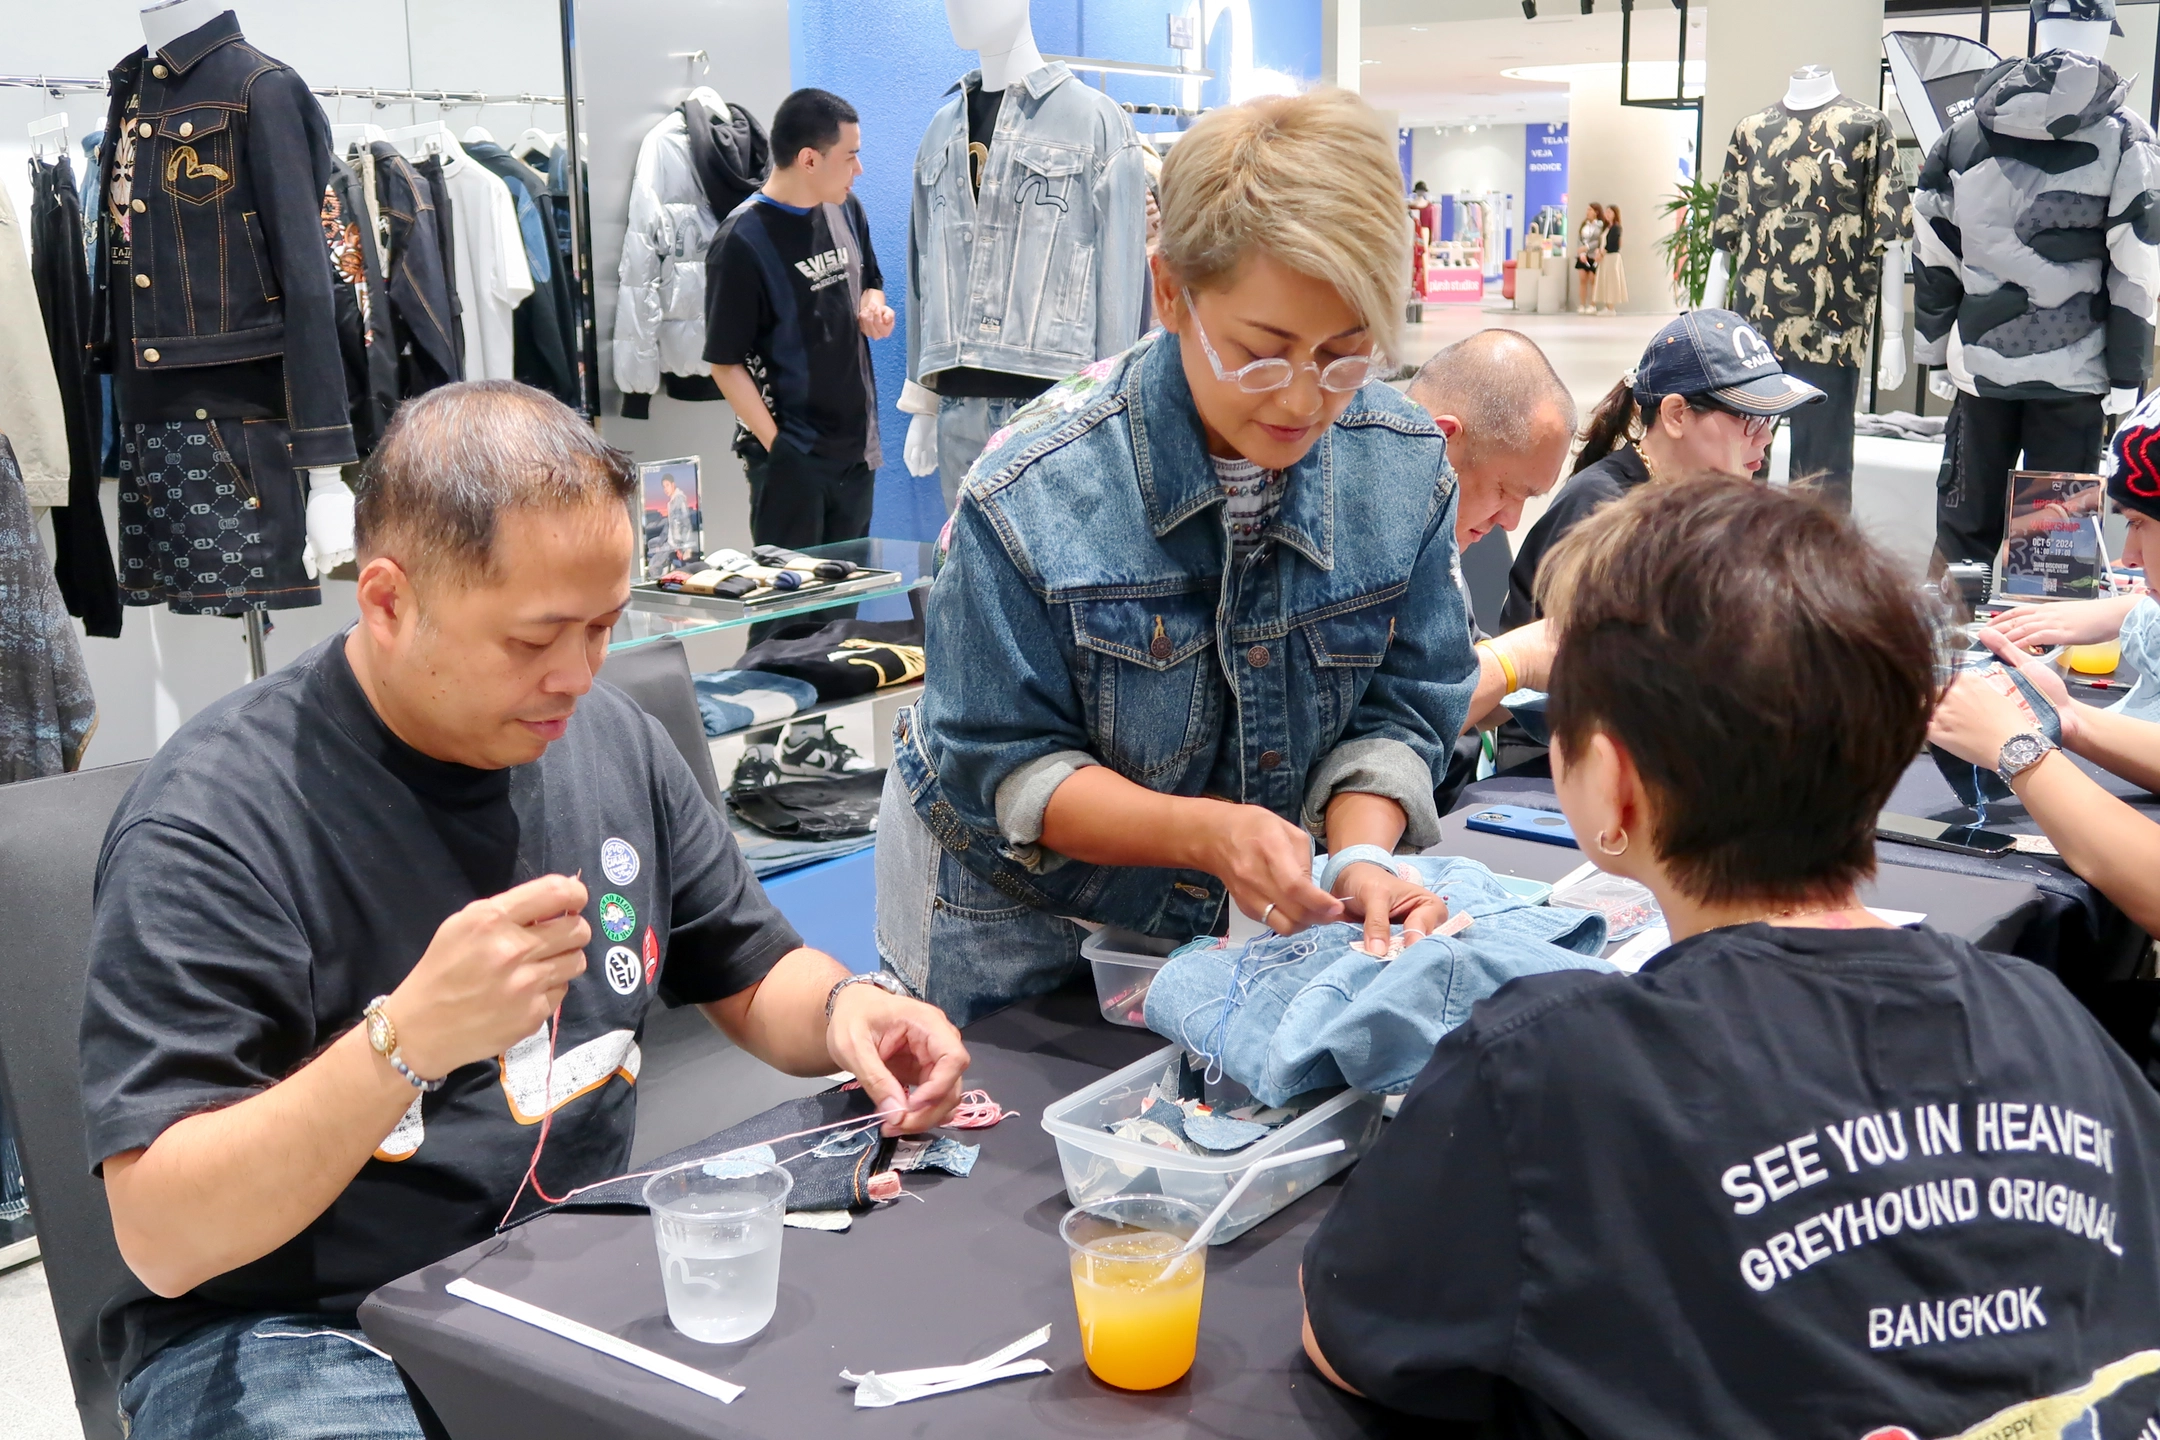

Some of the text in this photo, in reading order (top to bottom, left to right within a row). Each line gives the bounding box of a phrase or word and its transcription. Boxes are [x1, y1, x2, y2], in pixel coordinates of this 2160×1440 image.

[1541, 136, 1564, 145] TELA
[1531, 149, 1553, 158] VEJA
[1529, 163, 1562, 172] BODICE
[794, 247, 849, 279] EVISU
[1451, 279, 1479, 292] studios
[2031, 520, 2080, 532] WORKSHOP
[2032, 538, 2045, 547] OCT
[2056, 539, 2073, 549] 2024
[1721, 1102, 2115, 1216] SEE YOU IN HEAVEN
[1739, 1177, 2123, 1293] GREYHOUND ORIGINAL
[1868, 1286, 2048, 1349] BANGKOK
